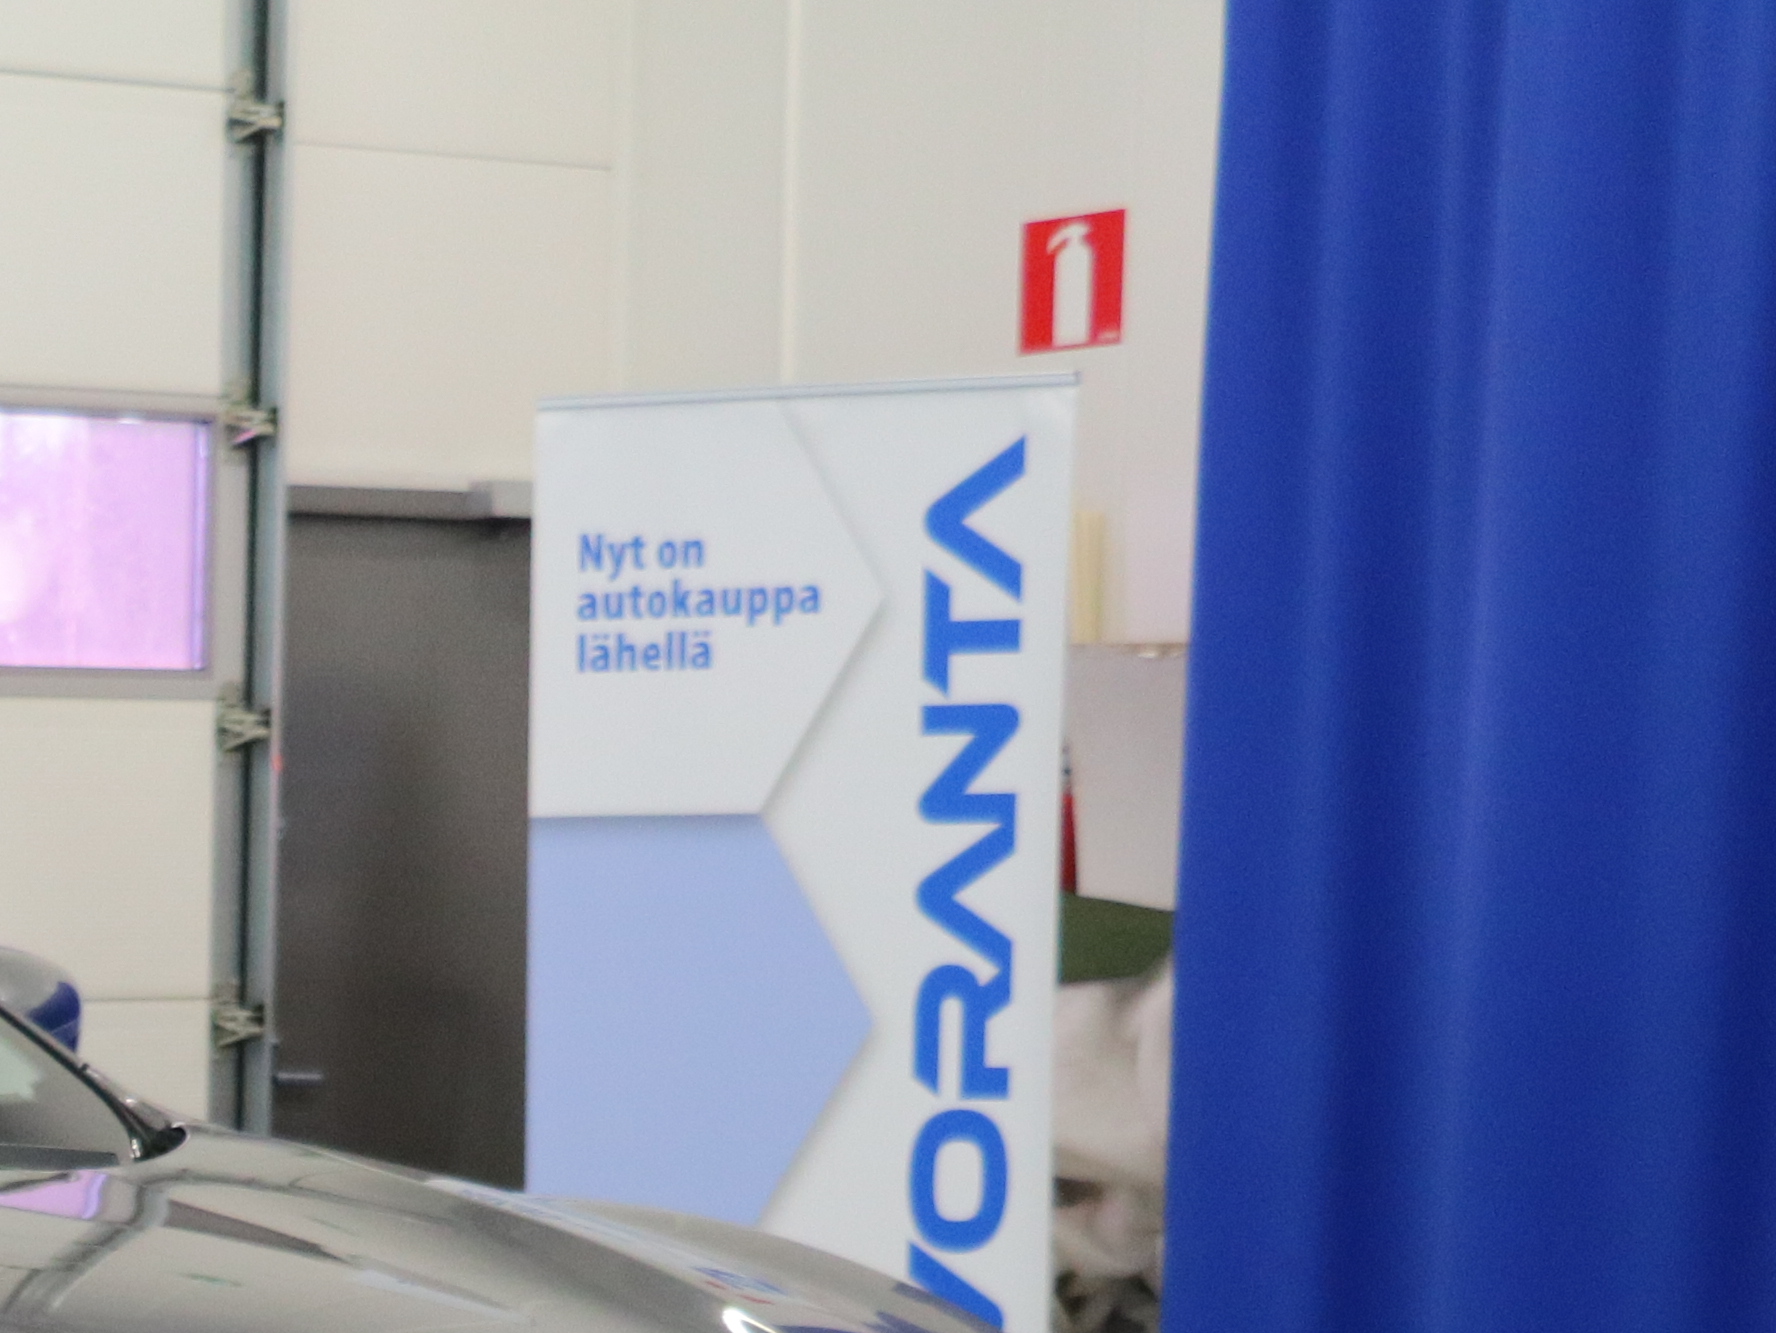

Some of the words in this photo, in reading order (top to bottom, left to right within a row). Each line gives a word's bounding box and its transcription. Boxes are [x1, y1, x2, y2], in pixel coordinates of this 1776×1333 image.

[578, 533, 645, 581] Nyt
[657, 539, 706, 569] on
[576, 578, 823, 627] autokauppa
[576, 630, 713, 673] lähellä
